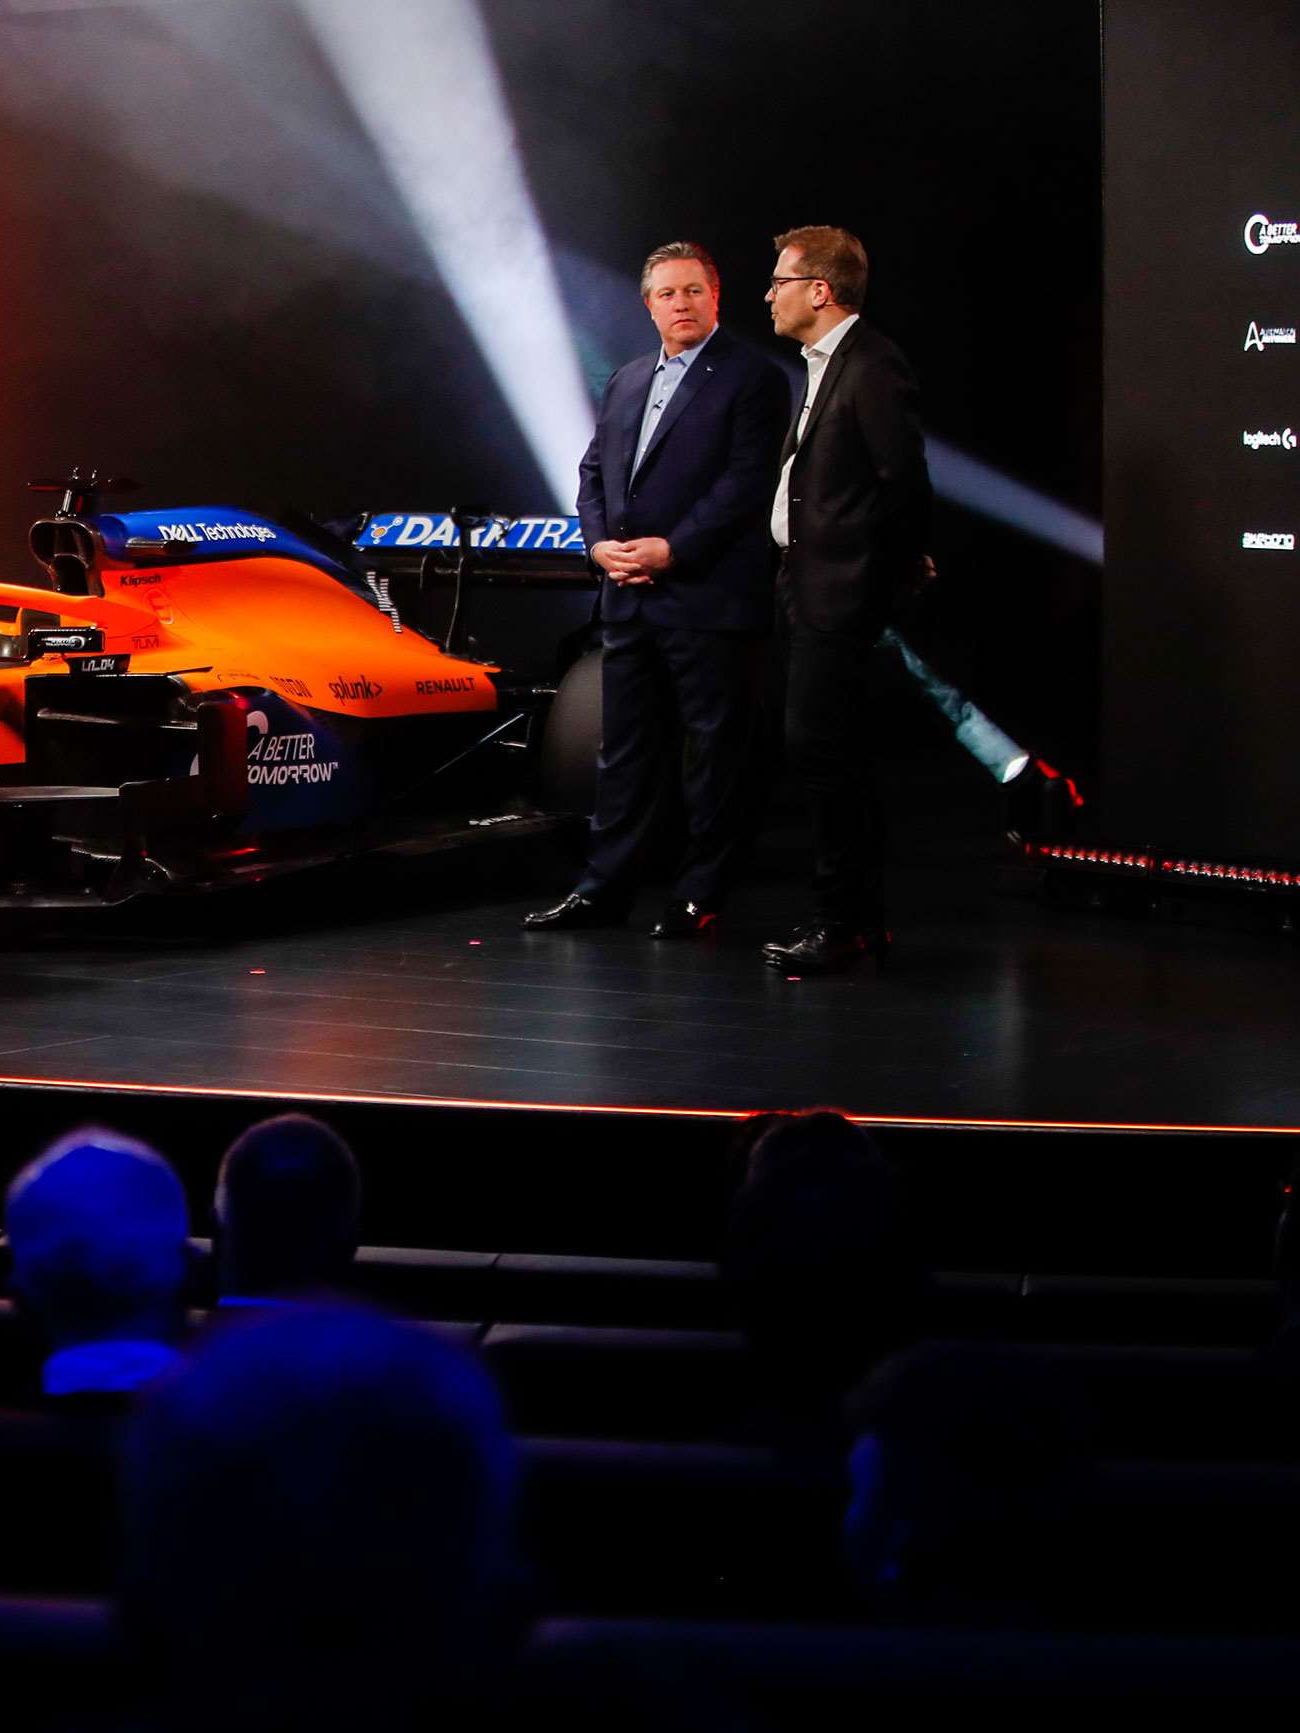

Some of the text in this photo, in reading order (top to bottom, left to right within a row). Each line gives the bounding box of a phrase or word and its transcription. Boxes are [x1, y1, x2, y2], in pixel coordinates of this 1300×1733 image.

[1267, 223, 1297, 235] BETTER
[158, 523, 277, 543] DELL Technologies
[120, 574, 162, 588] Klipsch
[328, 674, 383, 706] splunk>
[415, 677, 475, 695] RENAULT
[247, 733, 315, 760] A BETTER
[247, 762, 332, 785] OMORROW
